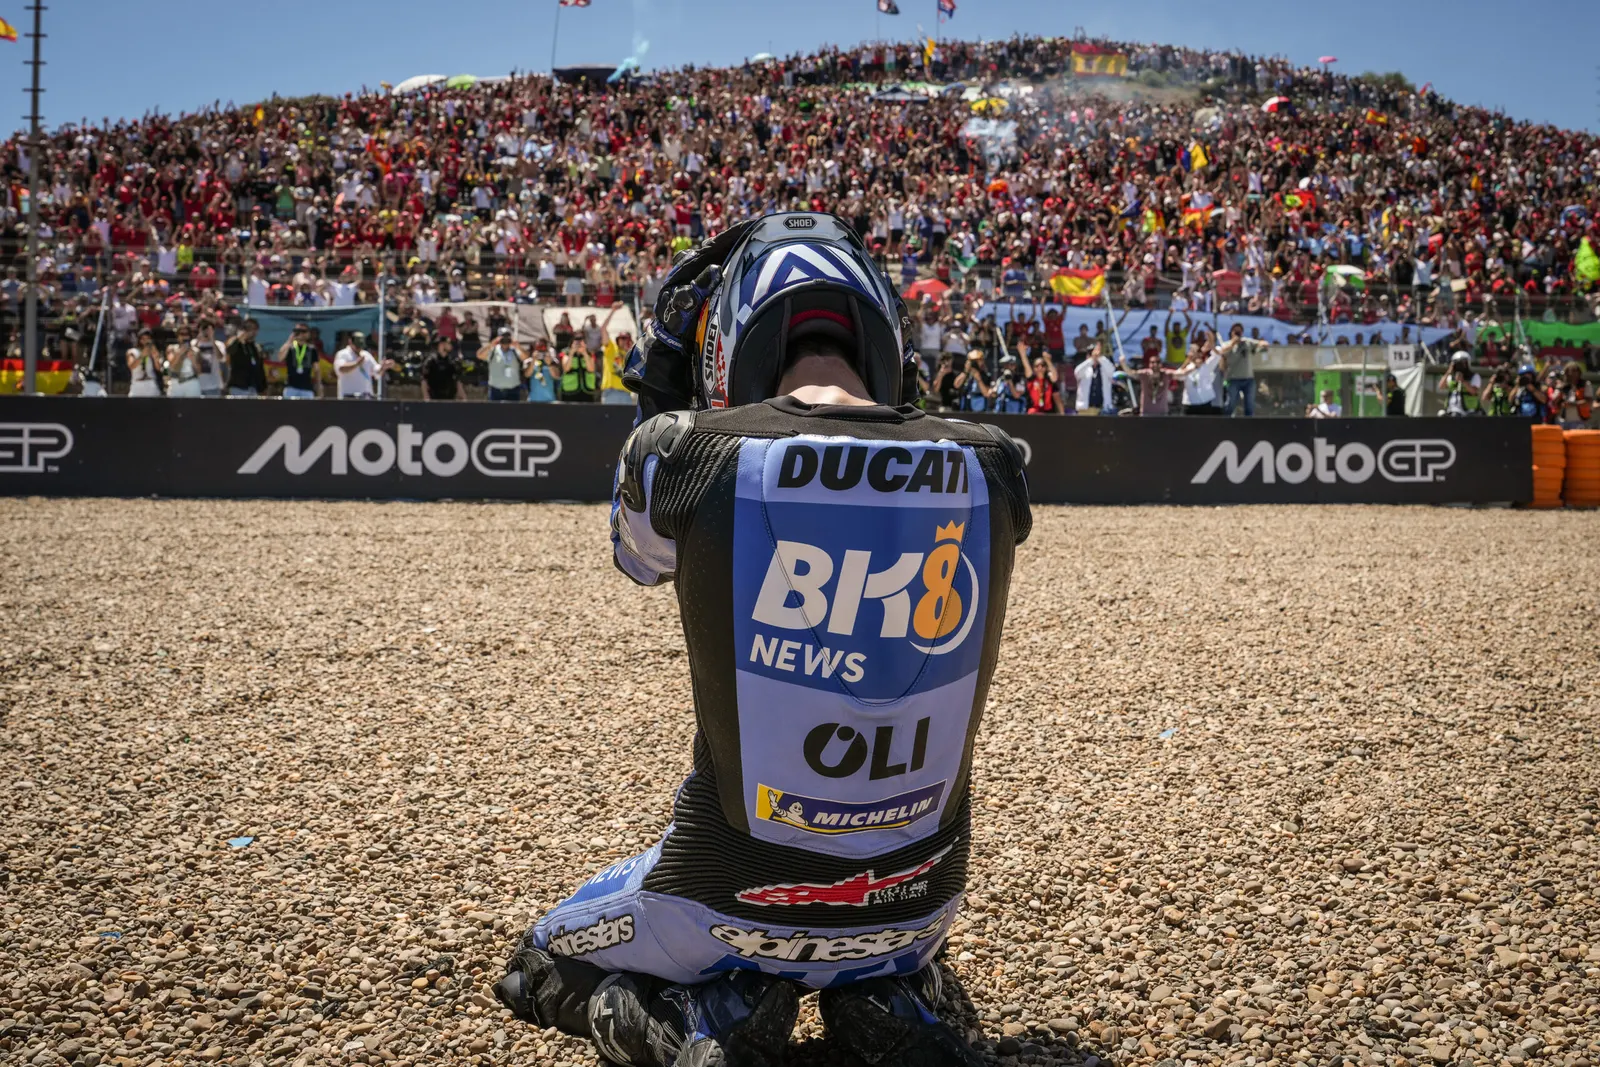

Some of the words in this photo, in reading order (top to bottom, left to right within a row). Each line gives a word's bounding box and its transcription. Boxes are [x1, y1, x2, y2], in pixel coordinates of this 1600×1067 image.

[788, 218, 813, 228] SHOEI
[704, 323, 718, 382] SHOEI
[751, 540, 963, 640] BK8
[750, 634, 867, 683] NEWS
[812, 797, 933, 826] MICHELIN
[711, 911, 948, 962] alpinestars
